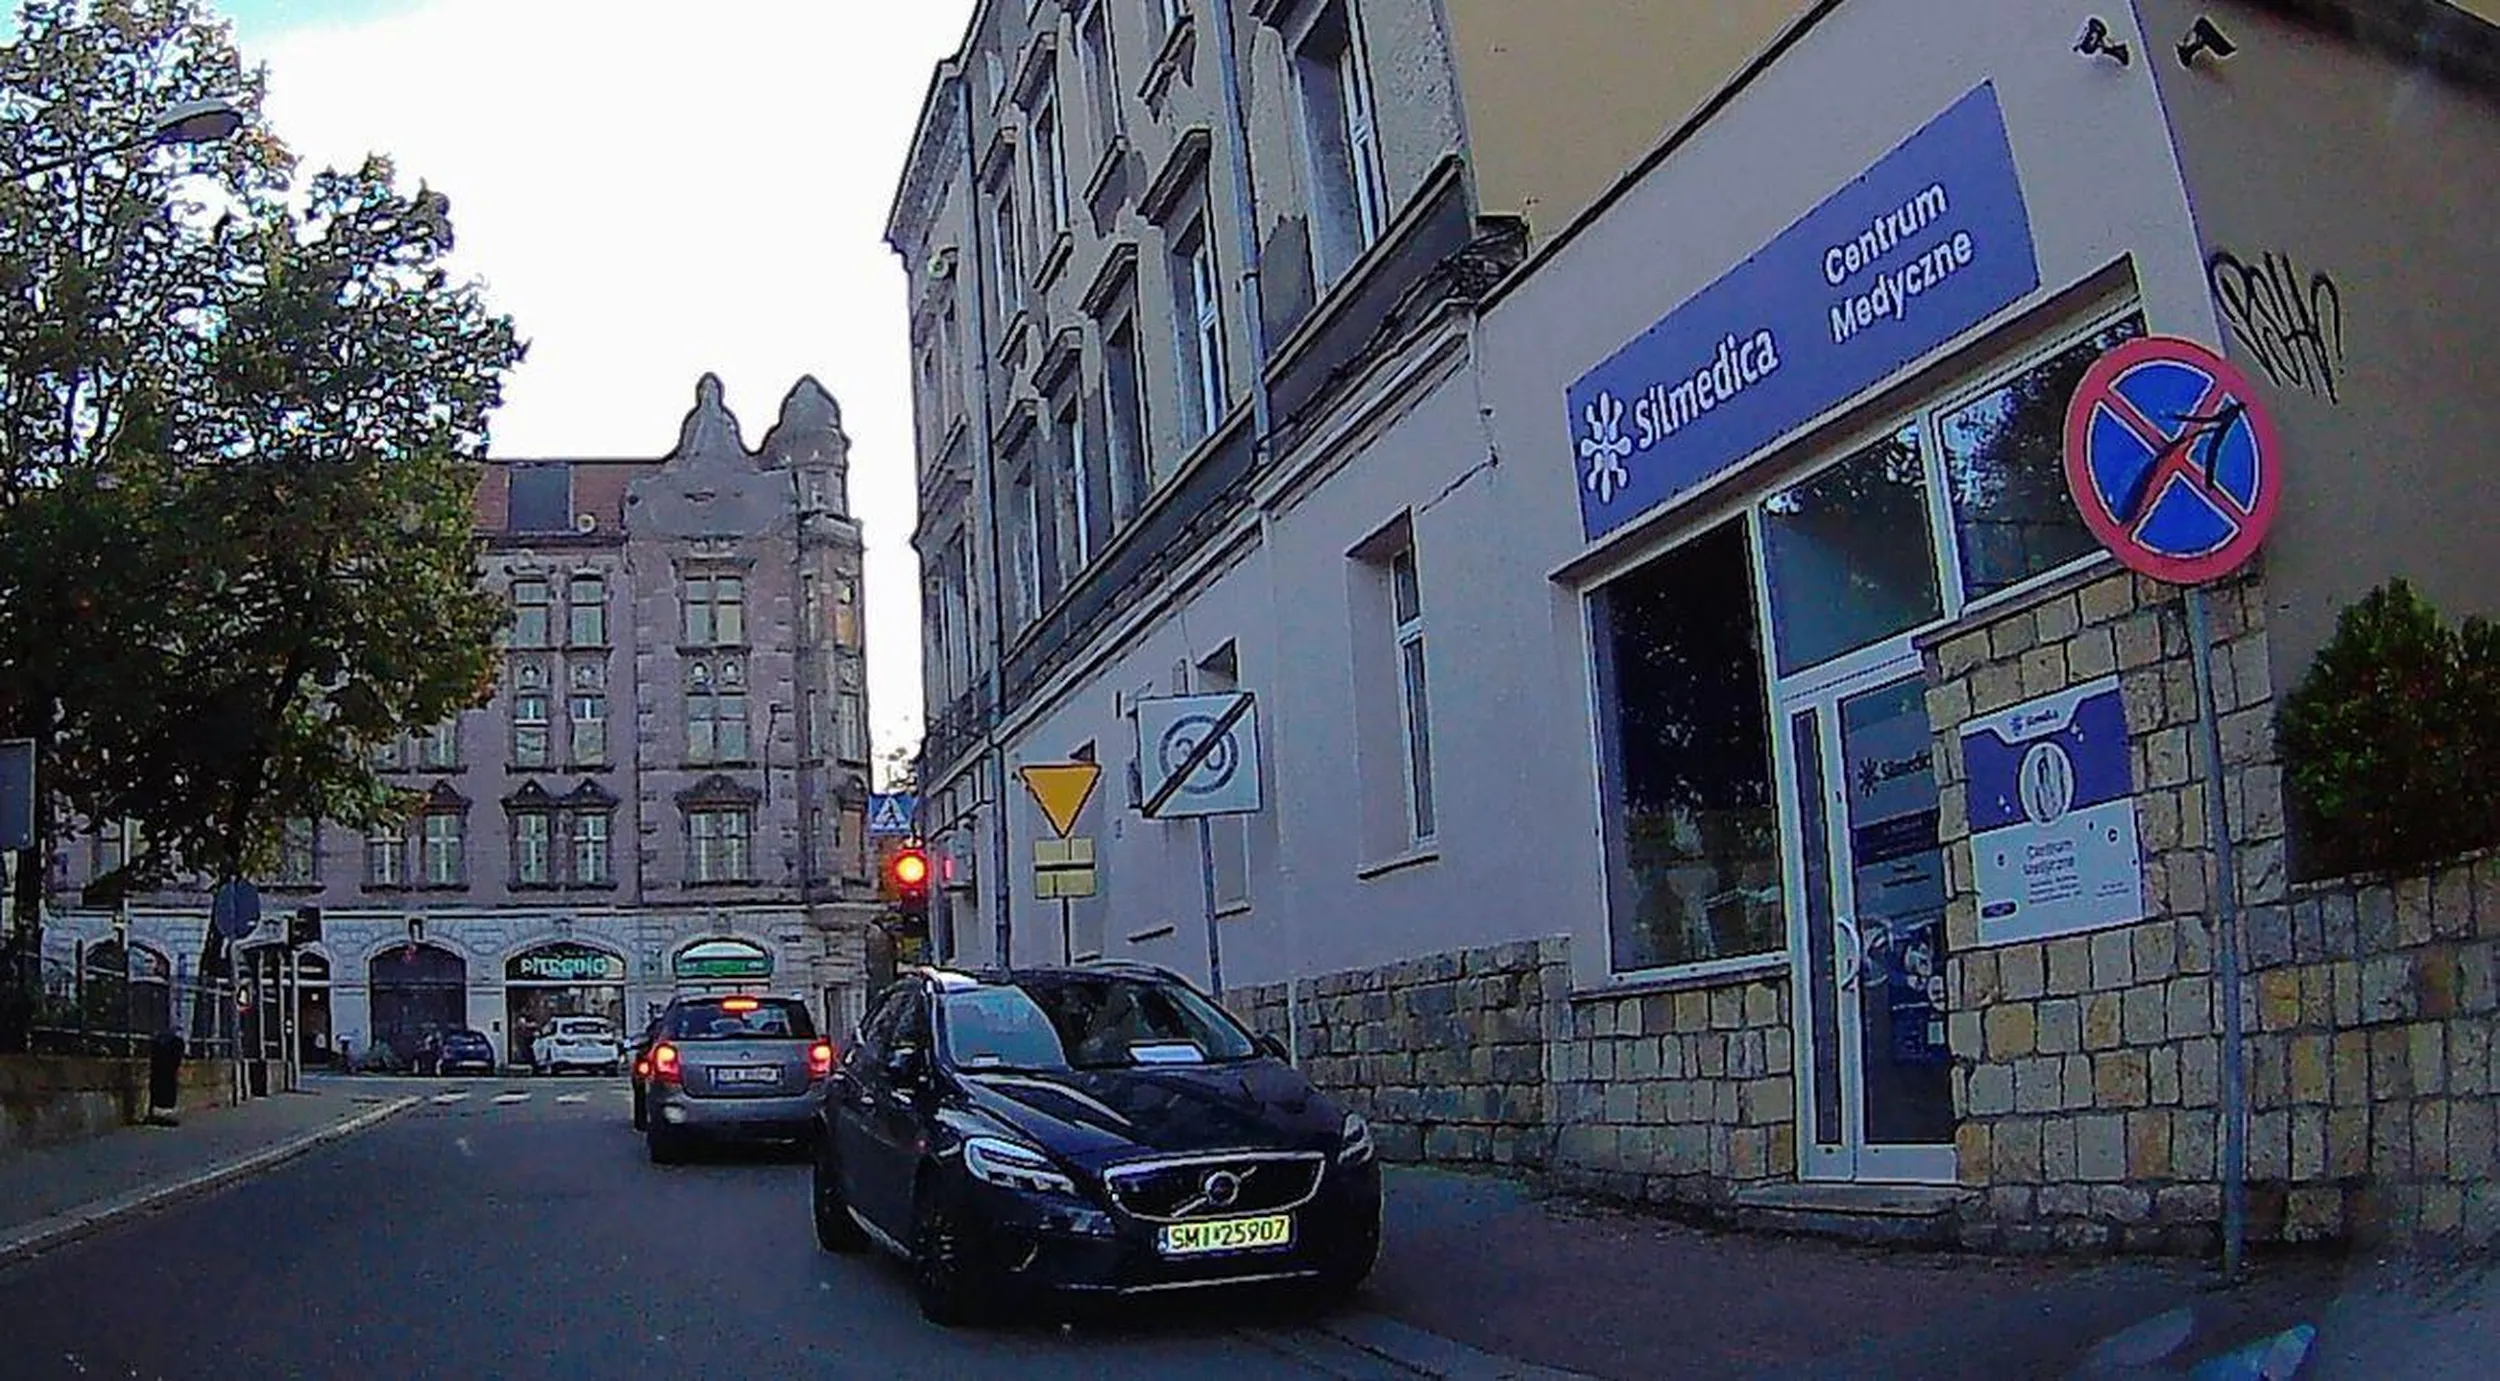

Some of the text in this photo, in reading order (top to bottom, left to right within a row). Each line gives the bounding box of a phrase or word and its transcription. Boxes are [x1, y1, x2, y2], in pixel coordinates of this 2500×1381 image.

[1824, 183, 1949, 285] Centrum
[1830, 231, 1974, 343] Medyczne
[1634, 330, 1779, 449] Silmedica
[1221, 1218, 1286, 1246] 25907
